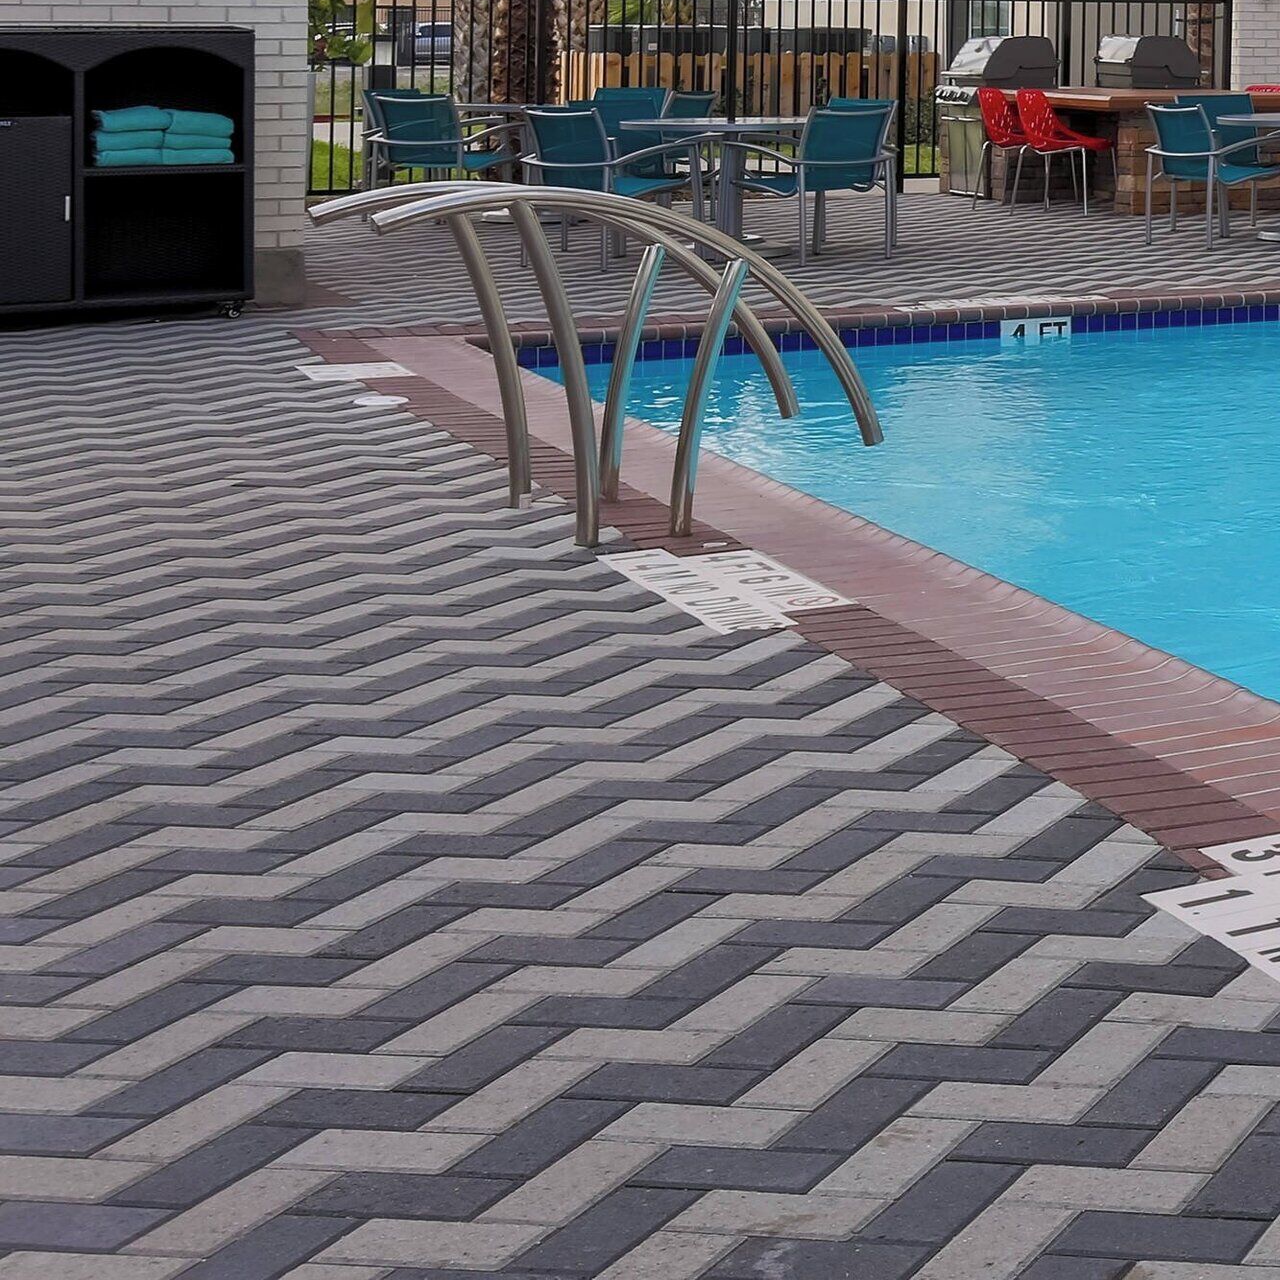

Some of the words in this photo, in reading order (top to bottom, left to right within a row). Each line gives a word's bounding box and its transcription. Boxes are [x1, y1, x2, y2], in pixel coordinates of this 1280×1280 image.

[1010, 324, 1025, 337] 4
[1040, 322, 1068, 336] FT
[701, 555, 751, 563] 4
[714, 561, 776, 575] FT
[642, 570, 698, 582] M
[738, 574, 790, 584] 6
[664, 580, 720, 594] NO
[752, 583, 817, 598] IN
[684, 595, 785, 630] DIVING
